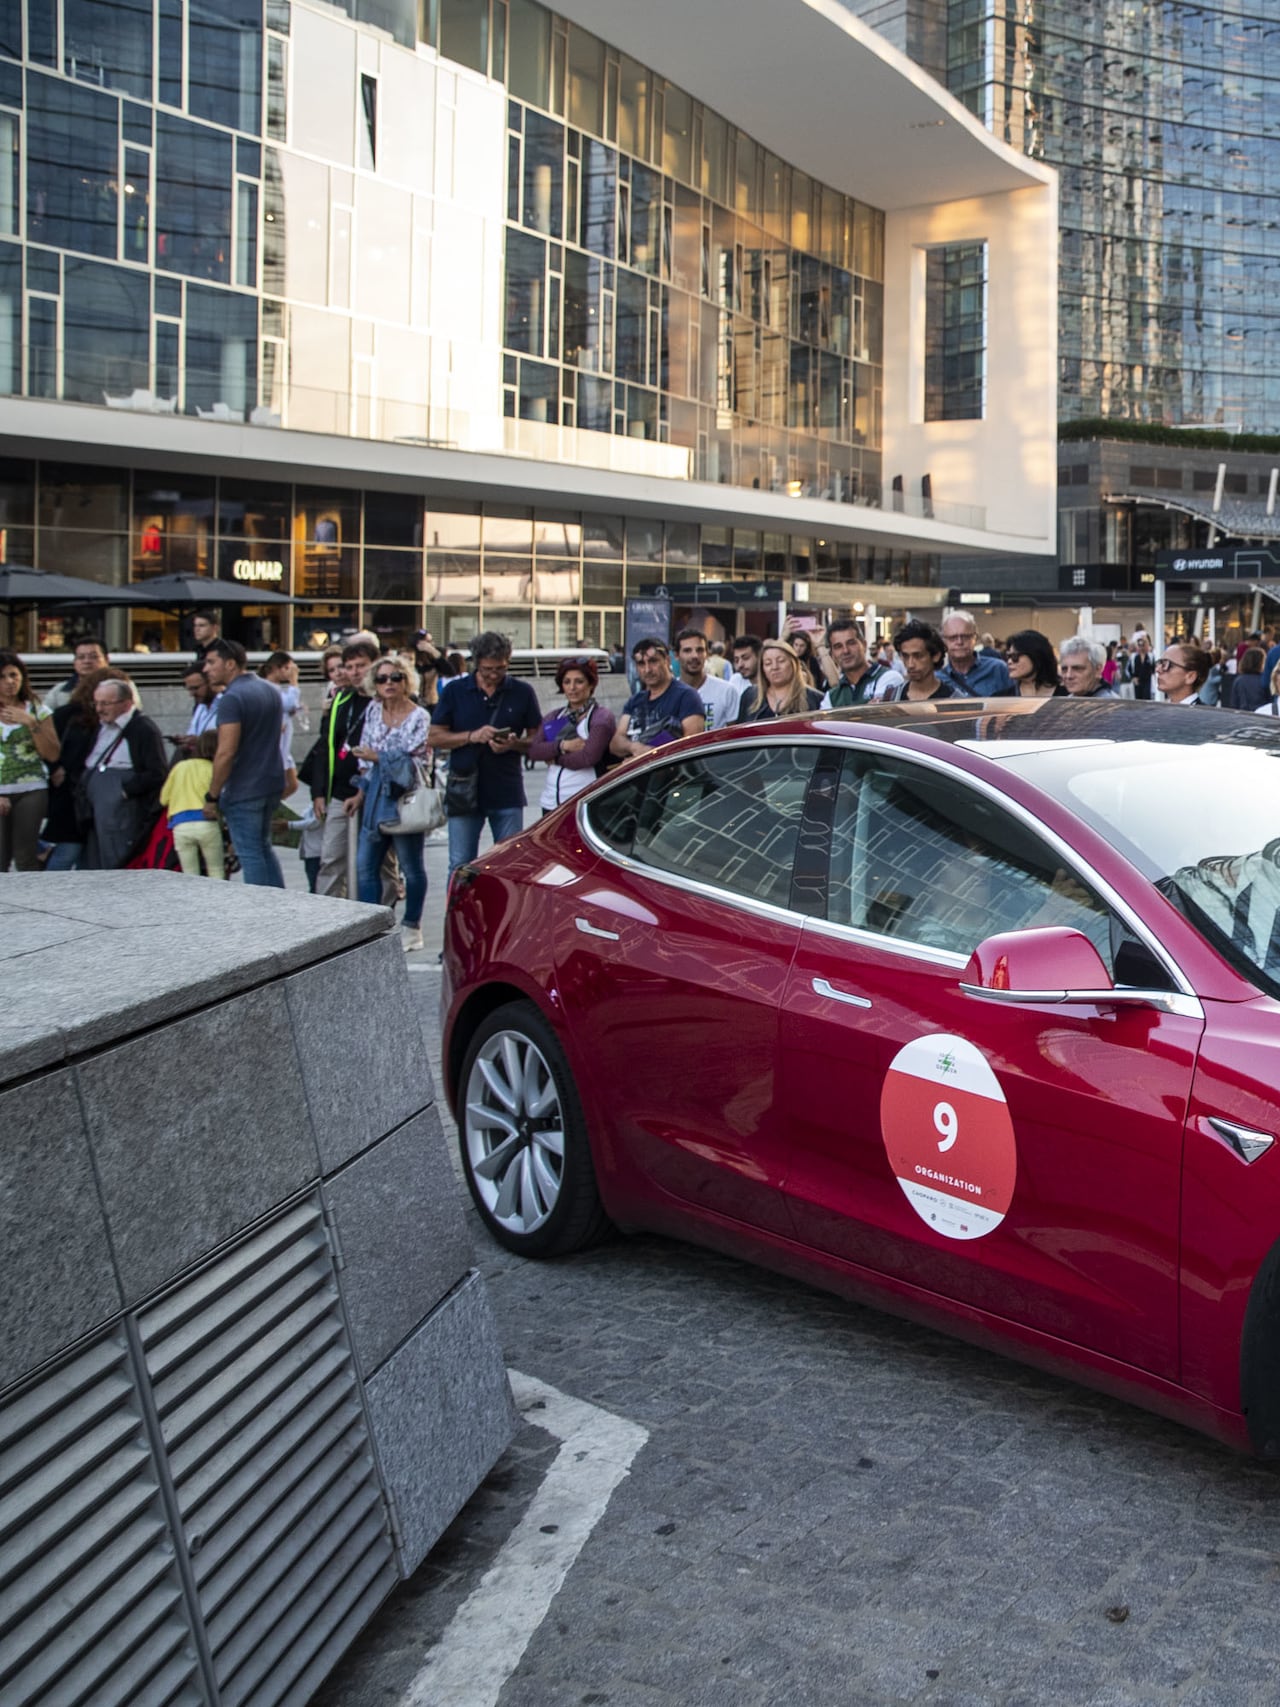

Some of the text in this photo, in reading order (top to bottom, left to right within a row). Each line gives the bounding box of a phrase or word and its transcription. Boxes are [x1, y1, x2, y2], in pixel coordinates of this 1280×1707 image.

[233, 559, 283, 581] COLMAR
[1188, 559, 1223, 569] HYUNDAI
[933, 1101, 958, 1153] 9
[915, 1164, 982, 1195] ORGANIZATION
